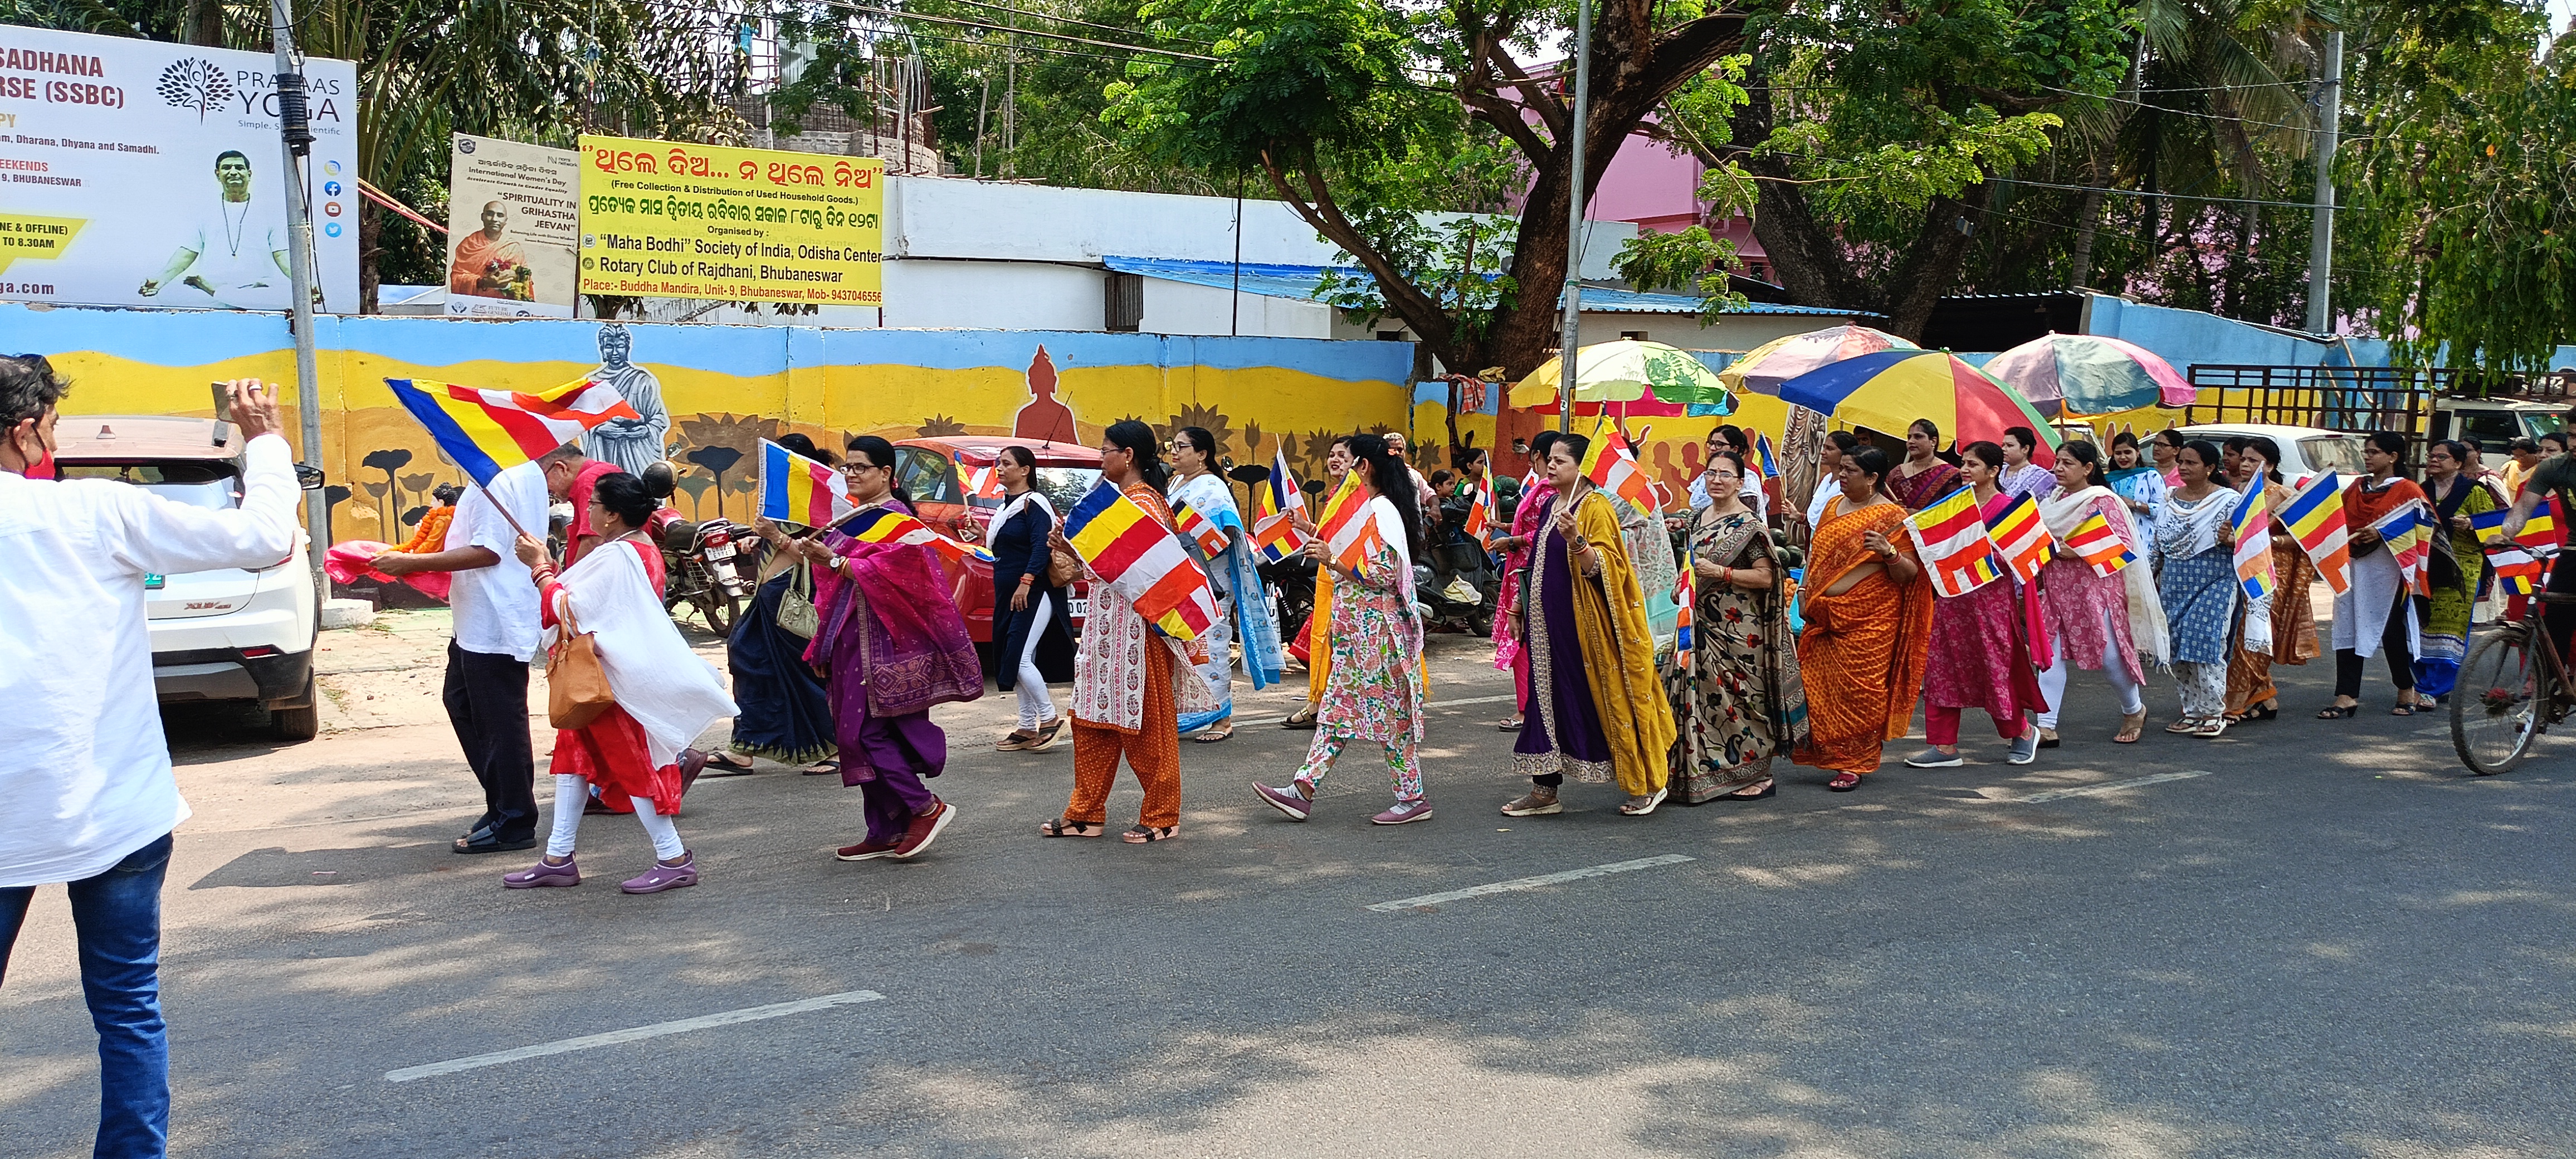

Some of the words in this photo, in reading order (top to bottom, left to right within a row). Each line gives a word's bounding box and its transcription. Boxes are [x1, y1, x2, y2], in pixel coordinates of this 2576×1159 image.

[238, 71, 340, 95] PRAAAS
[46, 81, 124, 109] (SSBC)
[238, 120, 271, 130] Simple.
[16, 135, 58, 147] Dharana,
[62, 139, 95, 149] Dhyana
[118, 143, 160, 154] Samadhi.
[2, 173, 10, 183] 9,
[13, 174, 81, 187] BHUBANESWAR
[469, 167, 516, 178] International
[518, 173, 551, 184] Women's
[552, 178, 567, 187] Day
[612, 179, 634, 189] (Free
[637, 182, 681, 192] Collection
[693, 186, 743, 196] Distribution
[780, 192, 824, 202] Household
[827, 195, 858, 205] Goods.)
[521, 207, 575, 221] GRIHASTHA
[567, 201, 576, 209] IN
[16, 223, 22, 232] &
[26, 224, 68, 235] OFFLINE)
[708, 226, 751, 236] Organised
[754, 228, 764, 237] by
[3, 237, 14, 246] TO
[18, 238, 55, 248] 8.30AM
[695, 239, 741, 259] Society
[746, 242, 758, 256] of
[762, 243, 794, 261] India,
[798, 245, 840, 260] Odisha
[844, 247, 882, 263] Center
[600, 257, 643, 276] Rotary
[648, 259, 677, 275] Club
[681, 261, 694, 276] of
[698, 262, 756, 280] Rajdhani,
[760, 265, 843, 282] Bhubaneswar
[584, 279, 618, 290] Place:-
[621, 280, 658, 293] Buddha
[661, 282, 701, 295] Mandira,
[705, 284, 727, 295] Unit-
[729, 285, 737, 296] 9,
[740, 285, 804, 300] Bhubaneswar,
[808, 288, 830, 300] Mob-
[832, 289, 881, 303] 9437046556
